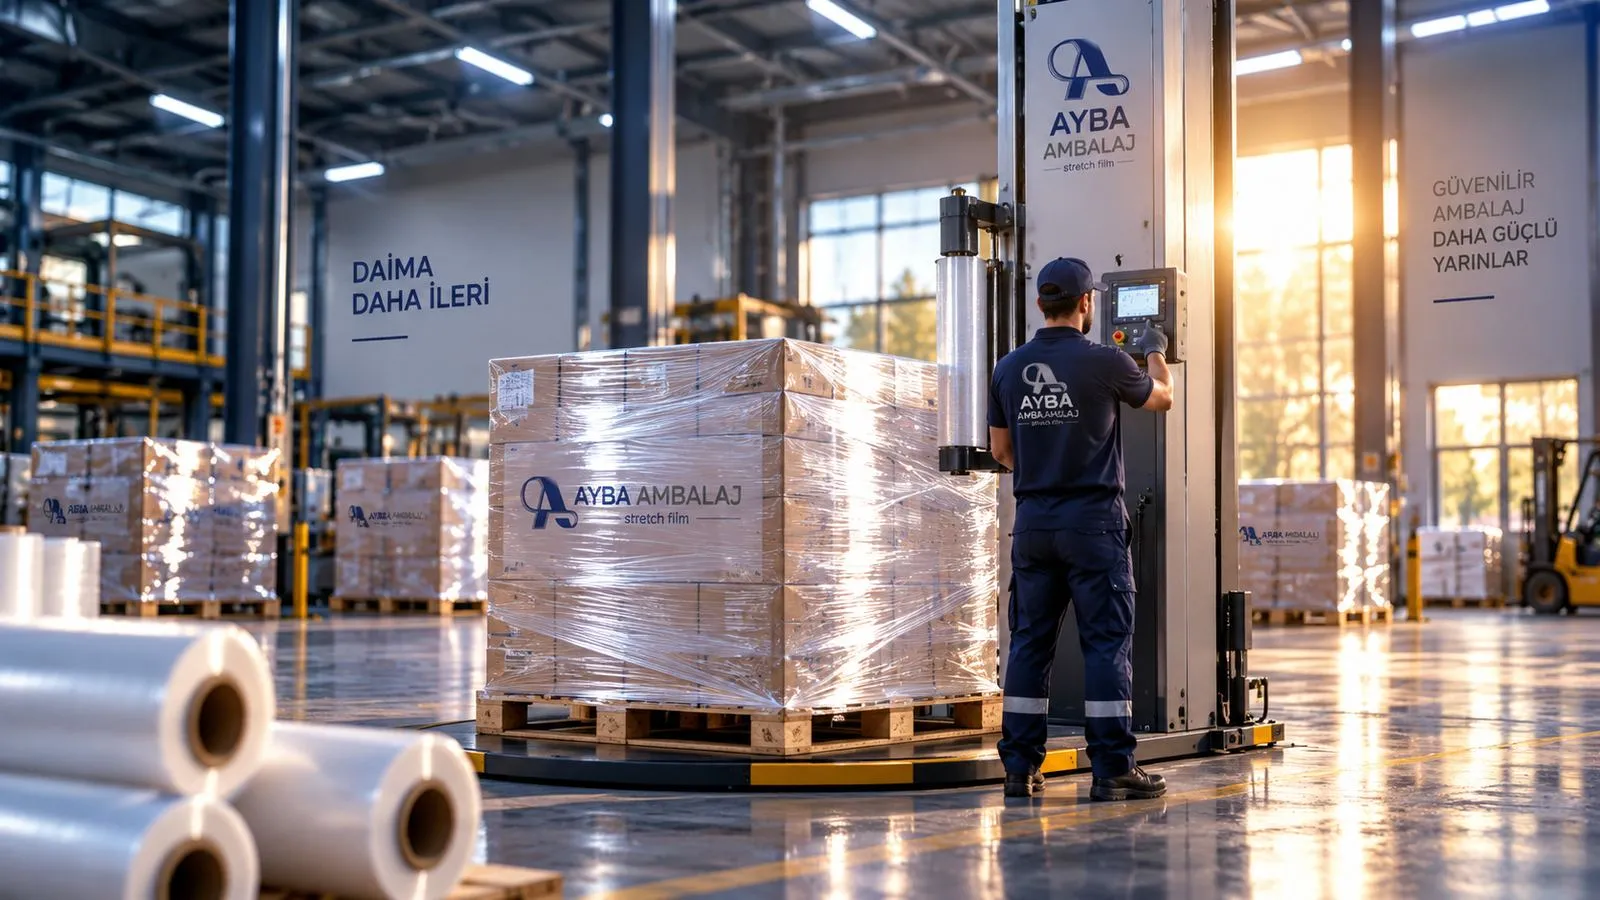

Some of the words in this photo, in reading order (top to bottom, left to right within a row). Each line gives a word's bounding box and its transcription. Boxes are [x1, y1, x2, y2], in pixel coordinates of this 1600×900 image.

[1050, 105, 1130, 136] AYBA
[1043, 134, 1135, 160] AMBALAJ
[1063, 161, 1095, 172] stretch
[1097, 159, 1115, 169] film
[1433, 169, 1535, 197] GÜVENİLİR
[1433, 198, 1524, 222] AMBALAJ
[1433, 227, 1487, 247] DAHA
[1492, 217, 1557, 243] GÜÇLÜ
[353, 252, 433, 283] DAİMA
[1433, 249, 1528, 273] YARINLAR
[353, 289, 422, 315] DAHA
[430, 277, 489, 309] İLERİ
[1020, 393, 1074, 410] AYBA
[574, 485, 631, 506] AYBA
[636, 485, 742, 506] AMBALAJ
[624, 512, 664, 524] stretch
[668, 511, 689, 524] film
